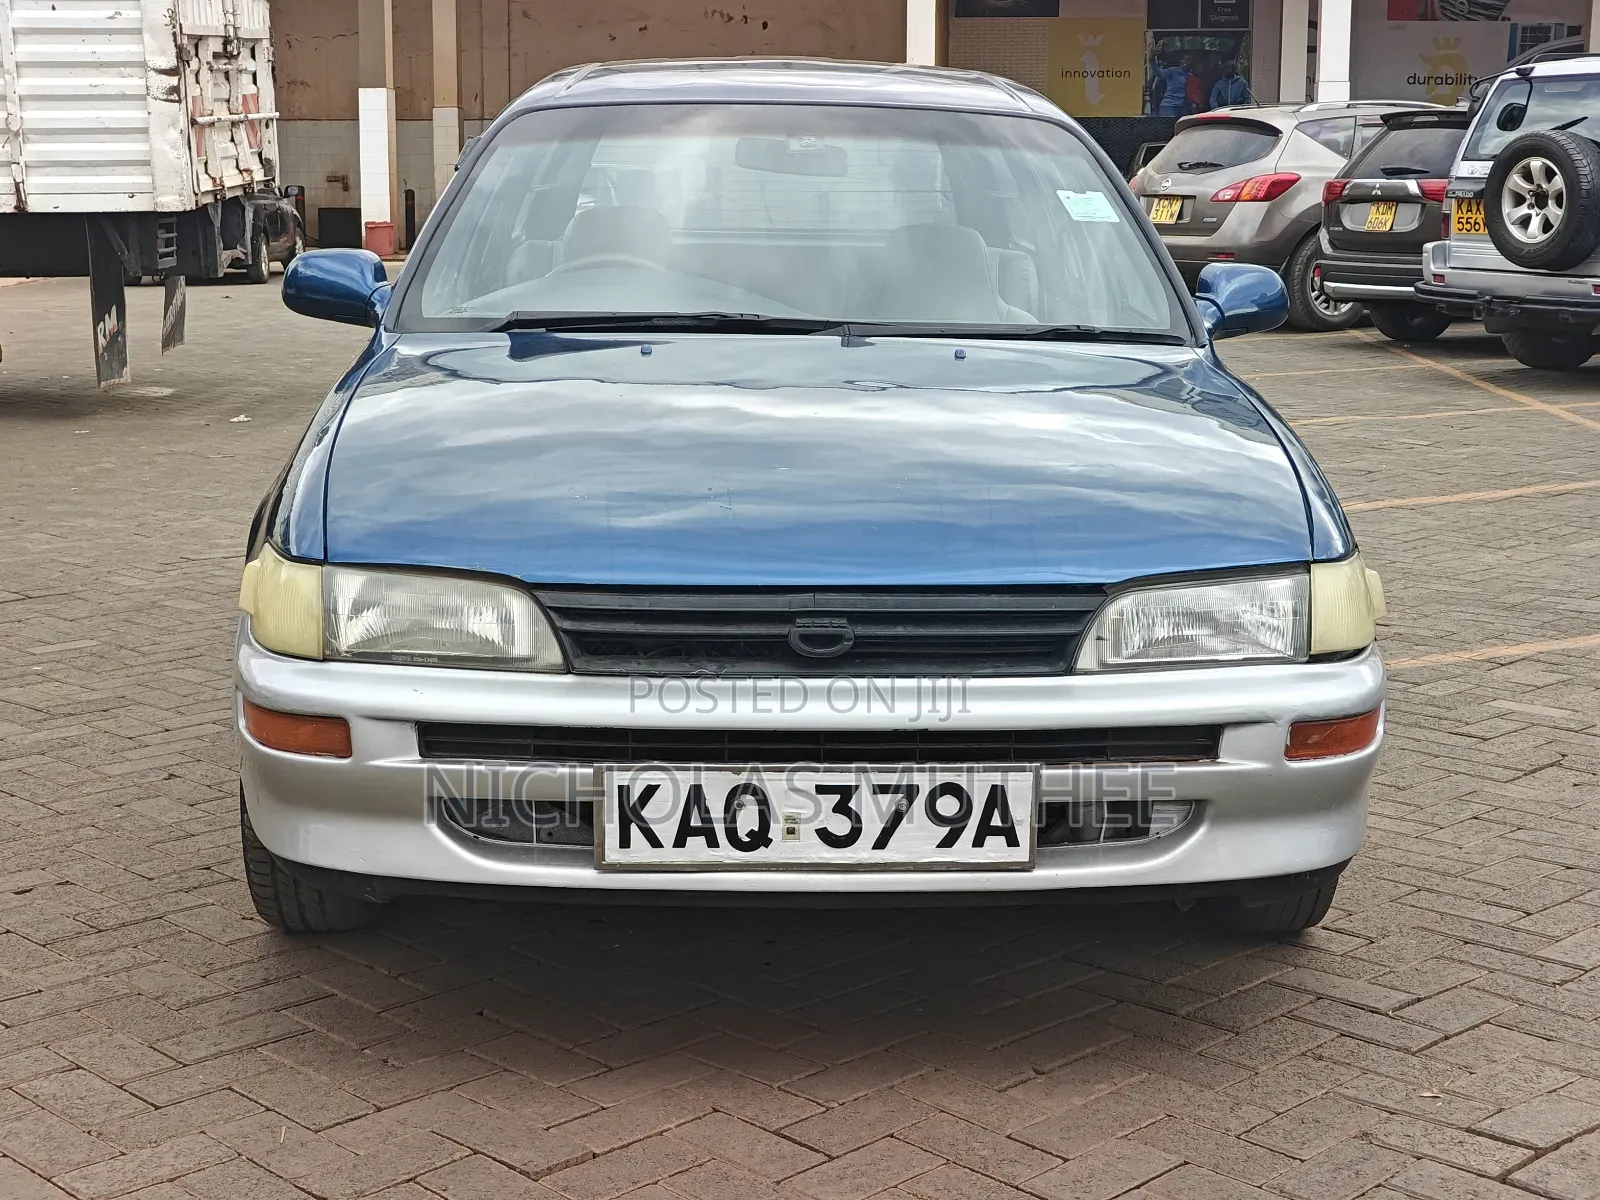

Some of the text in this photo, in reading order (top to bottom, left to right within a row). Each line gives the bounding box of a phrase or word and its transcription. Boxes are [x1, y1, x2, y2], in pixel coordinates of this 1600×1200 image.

[1061, 67, 1131, 79] innovation
[1456, 199, 1482, 216] KAX
[97, 303, 119, 357] RM
[617, 781, 1021, 853] KAQ 379A
